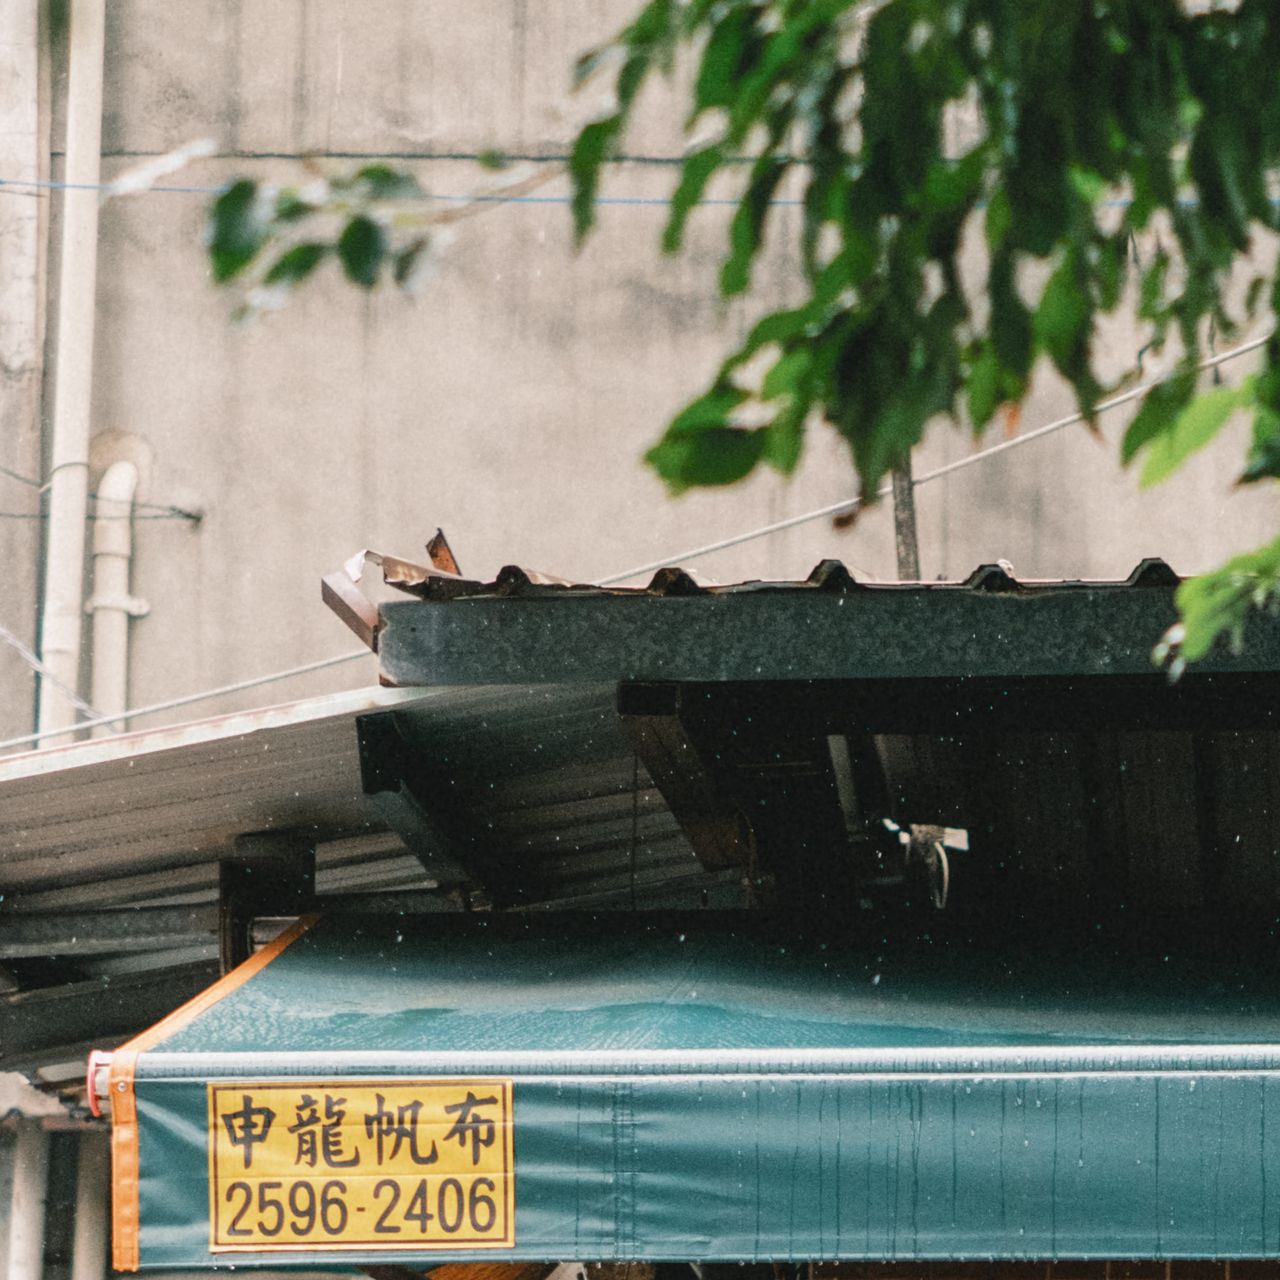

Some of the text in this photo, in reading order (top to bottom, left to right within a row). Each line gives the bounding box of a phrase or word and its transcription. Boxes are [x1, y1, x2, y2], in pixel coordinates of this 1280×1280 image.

[221, 1091, 499, 1170] 申龍帆布
[226, 1177, 497, 1237] 2596-2406
